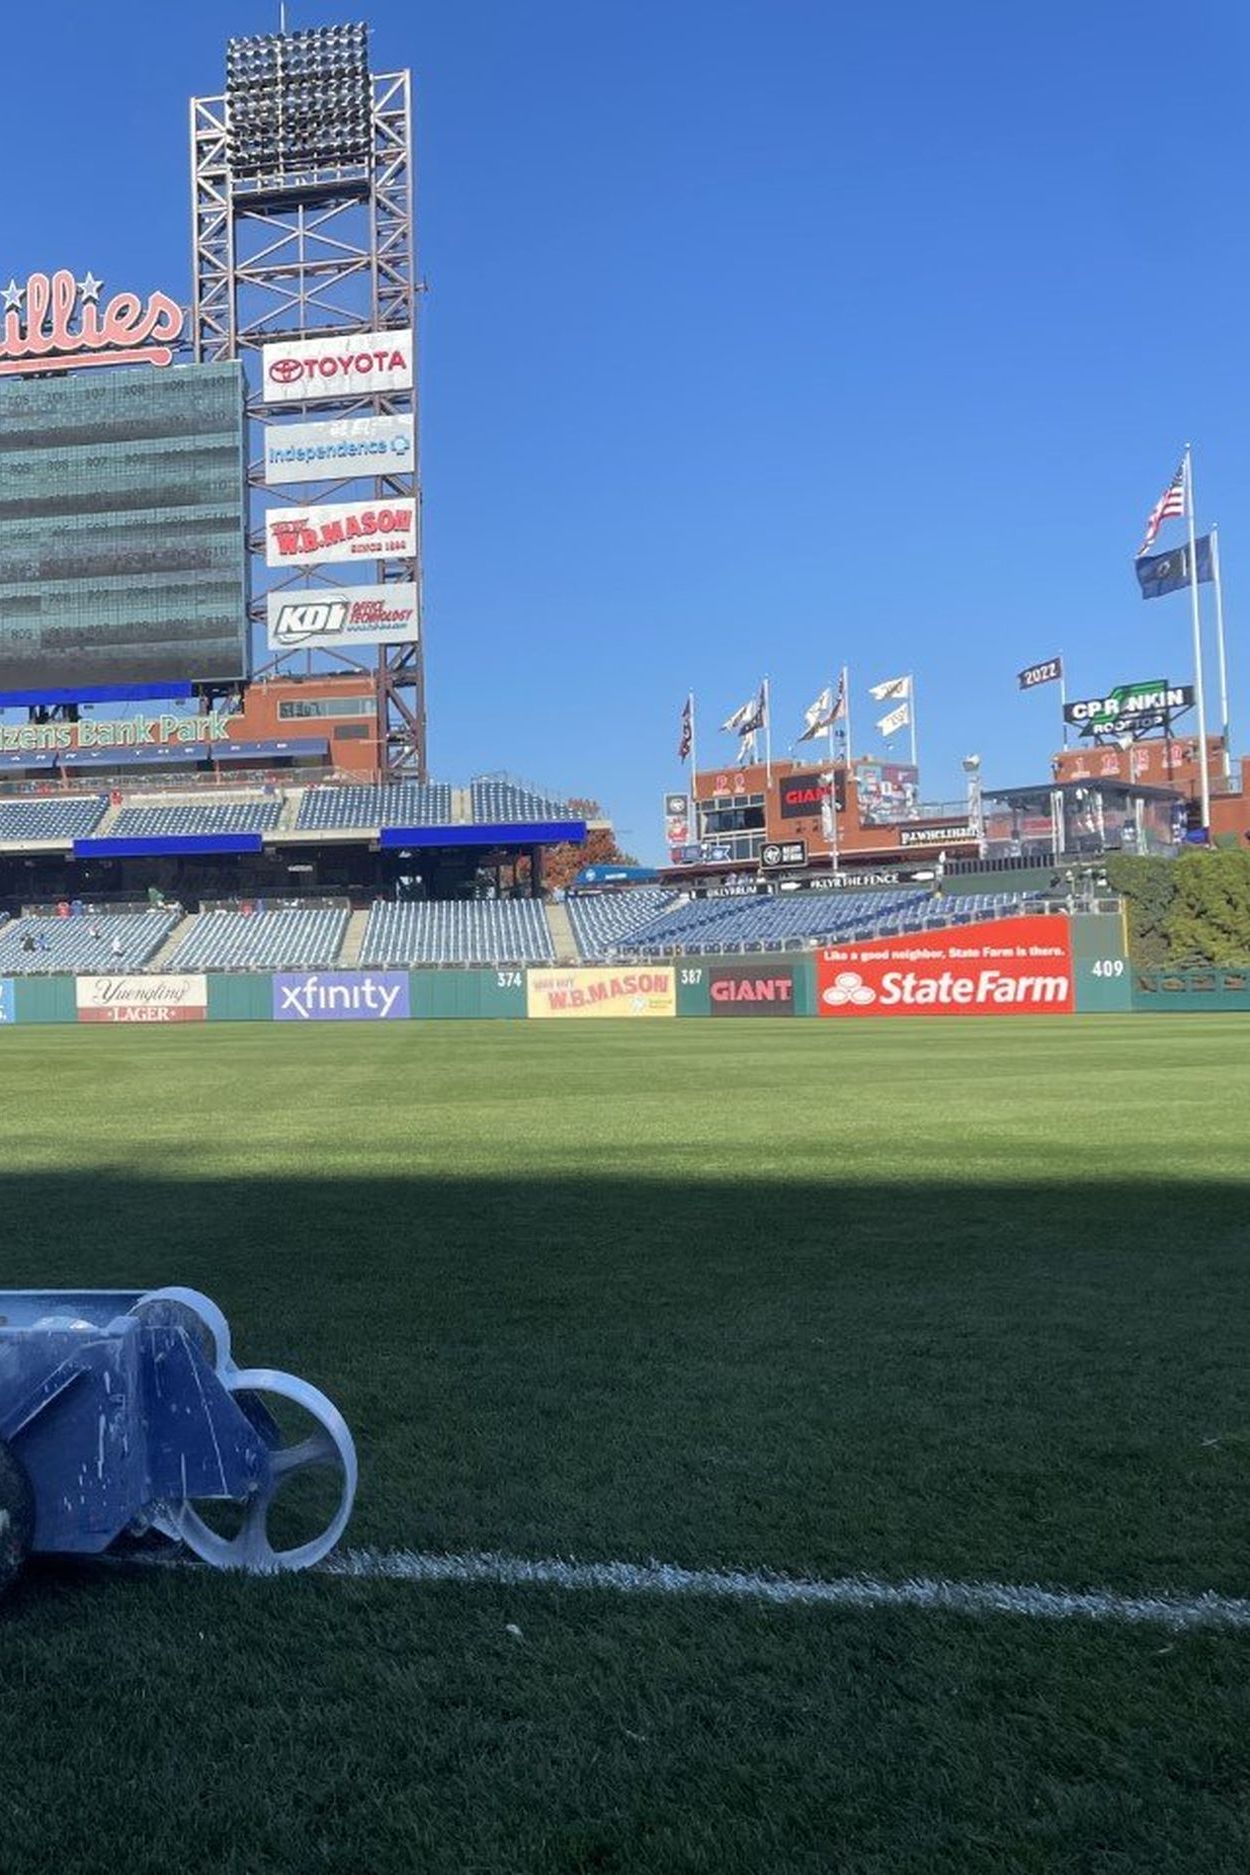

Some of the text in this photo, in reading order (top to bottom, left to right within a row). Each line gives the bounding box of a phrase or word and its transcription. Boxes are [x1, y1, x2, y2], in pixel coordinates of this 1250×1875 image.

[303, 351, 407, 379] TOYOTA
[269, 439, 388, 464] Independence
[274, 602, 350, 636] KDI
[1024, 662, 1058, 686] 2022
[78, 716, 156, 748] Bank
[159, 711, 231, 743] Park
[824, 951, 848, 961] Like
[861, 951, 888, 963] good
[891, 948, 946, 961] neighbor,
[949, 947, 980, 959] State
[982, 946, 1014, 958] Farm
[1015, 945, 1027, 957] is
[1029, 945, 1065, 957] there.
[497, 972, 523, 988] 374
[680, 969, 702, 985] 387
[1092, 960, 1124, 977] 409
[94, 978, 191, 1005] Yuengling
[281, 975, 401, 1018] xfinity
[710, 979, 793, 1001] GIANT
[113, 1007, 171, 1021] LAGER
